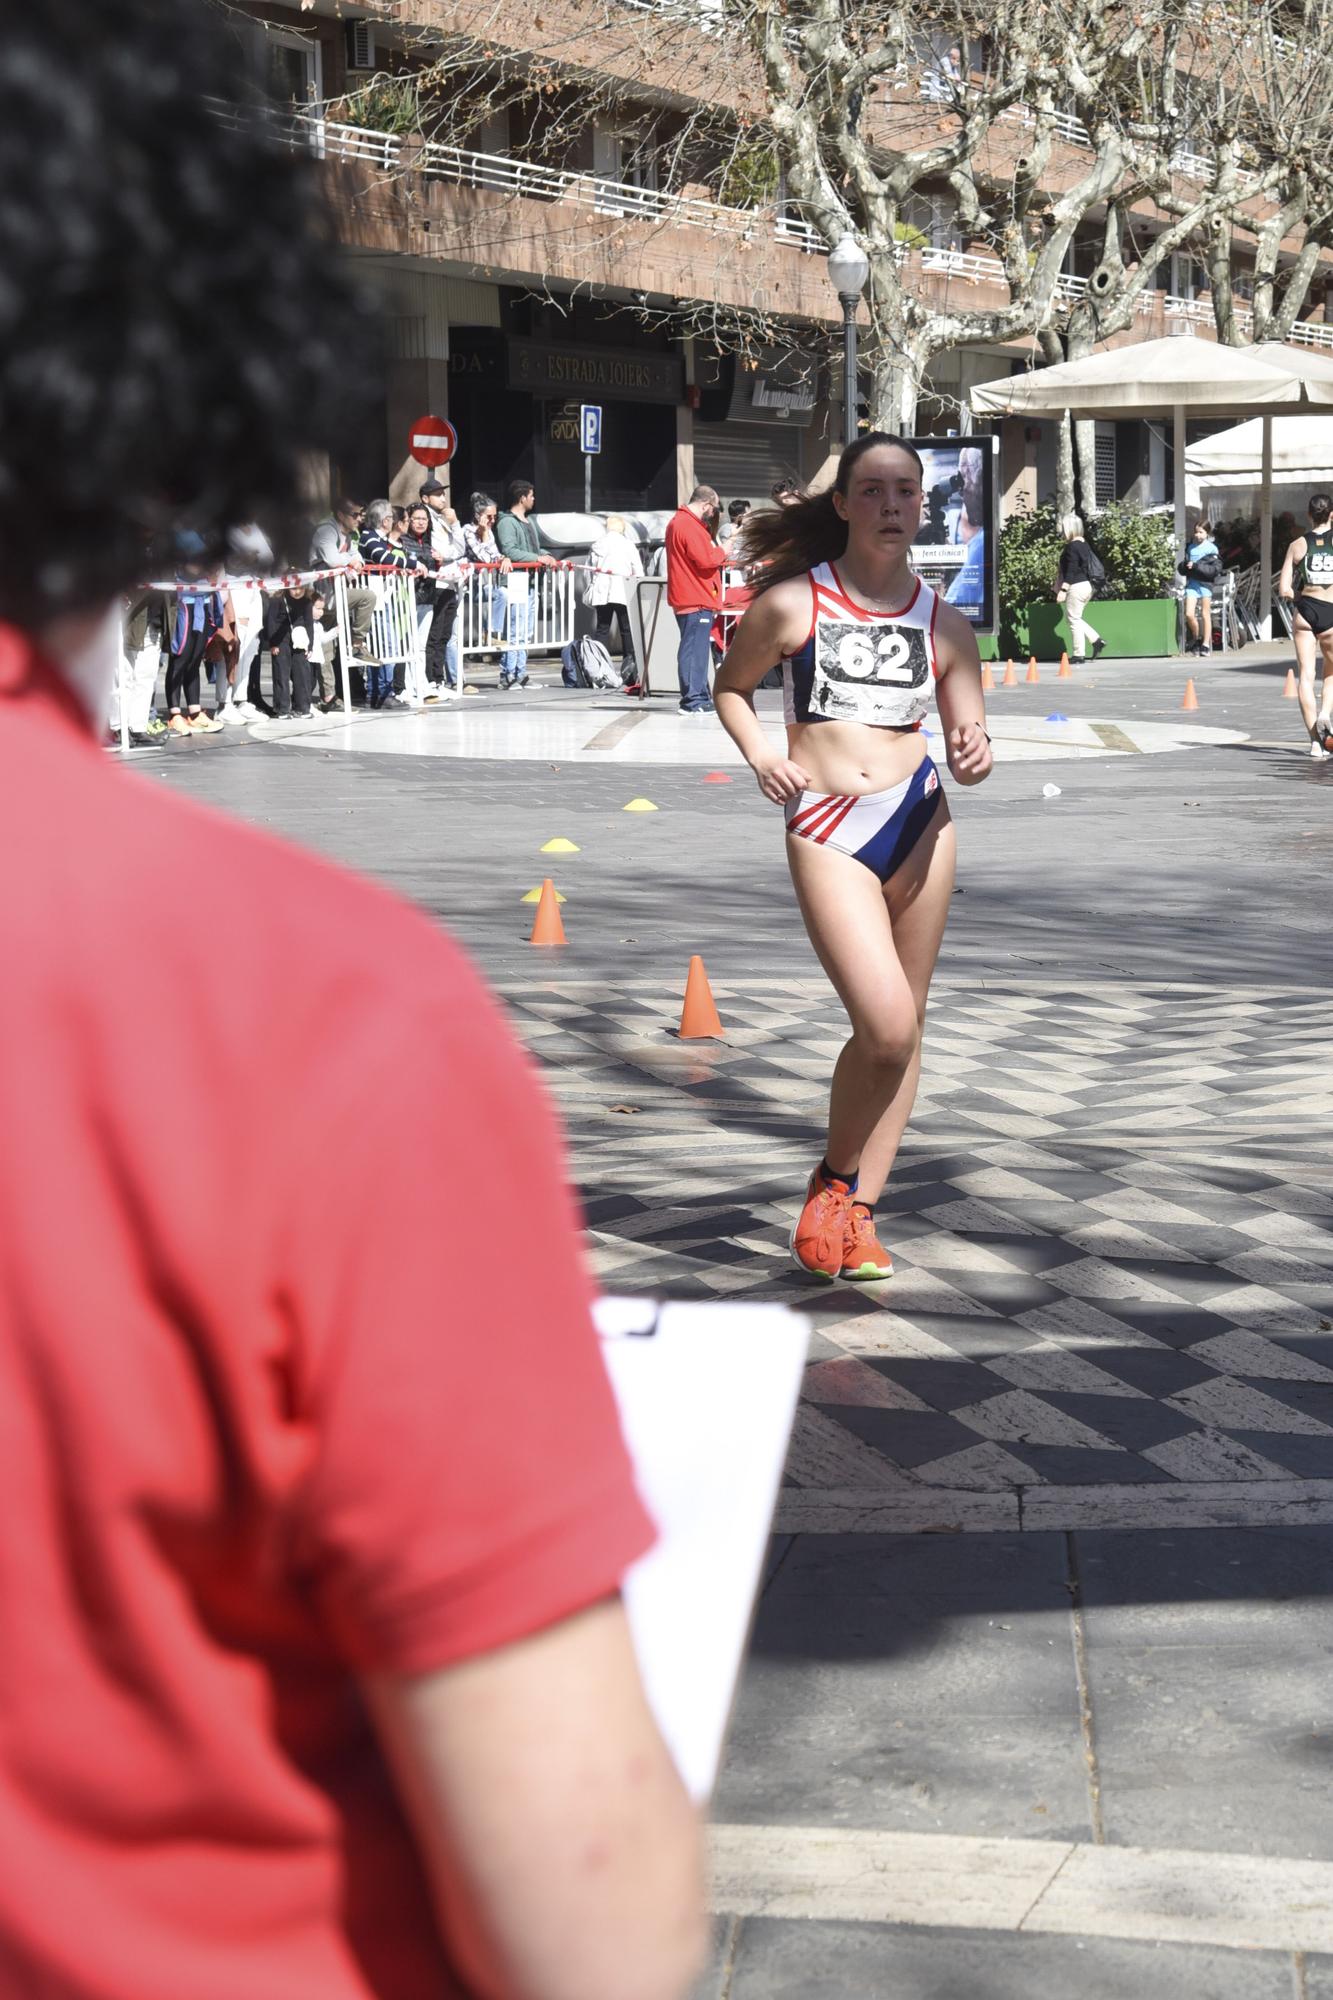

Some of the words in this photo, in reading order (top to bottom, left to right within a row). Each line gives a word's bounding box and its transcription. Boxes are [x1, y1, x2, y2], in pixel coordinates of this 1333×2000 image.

[548, 355, 606, 384] ESTRADA
[586, 412, 598, 447] P
[839, 632, 913, 682] 62
